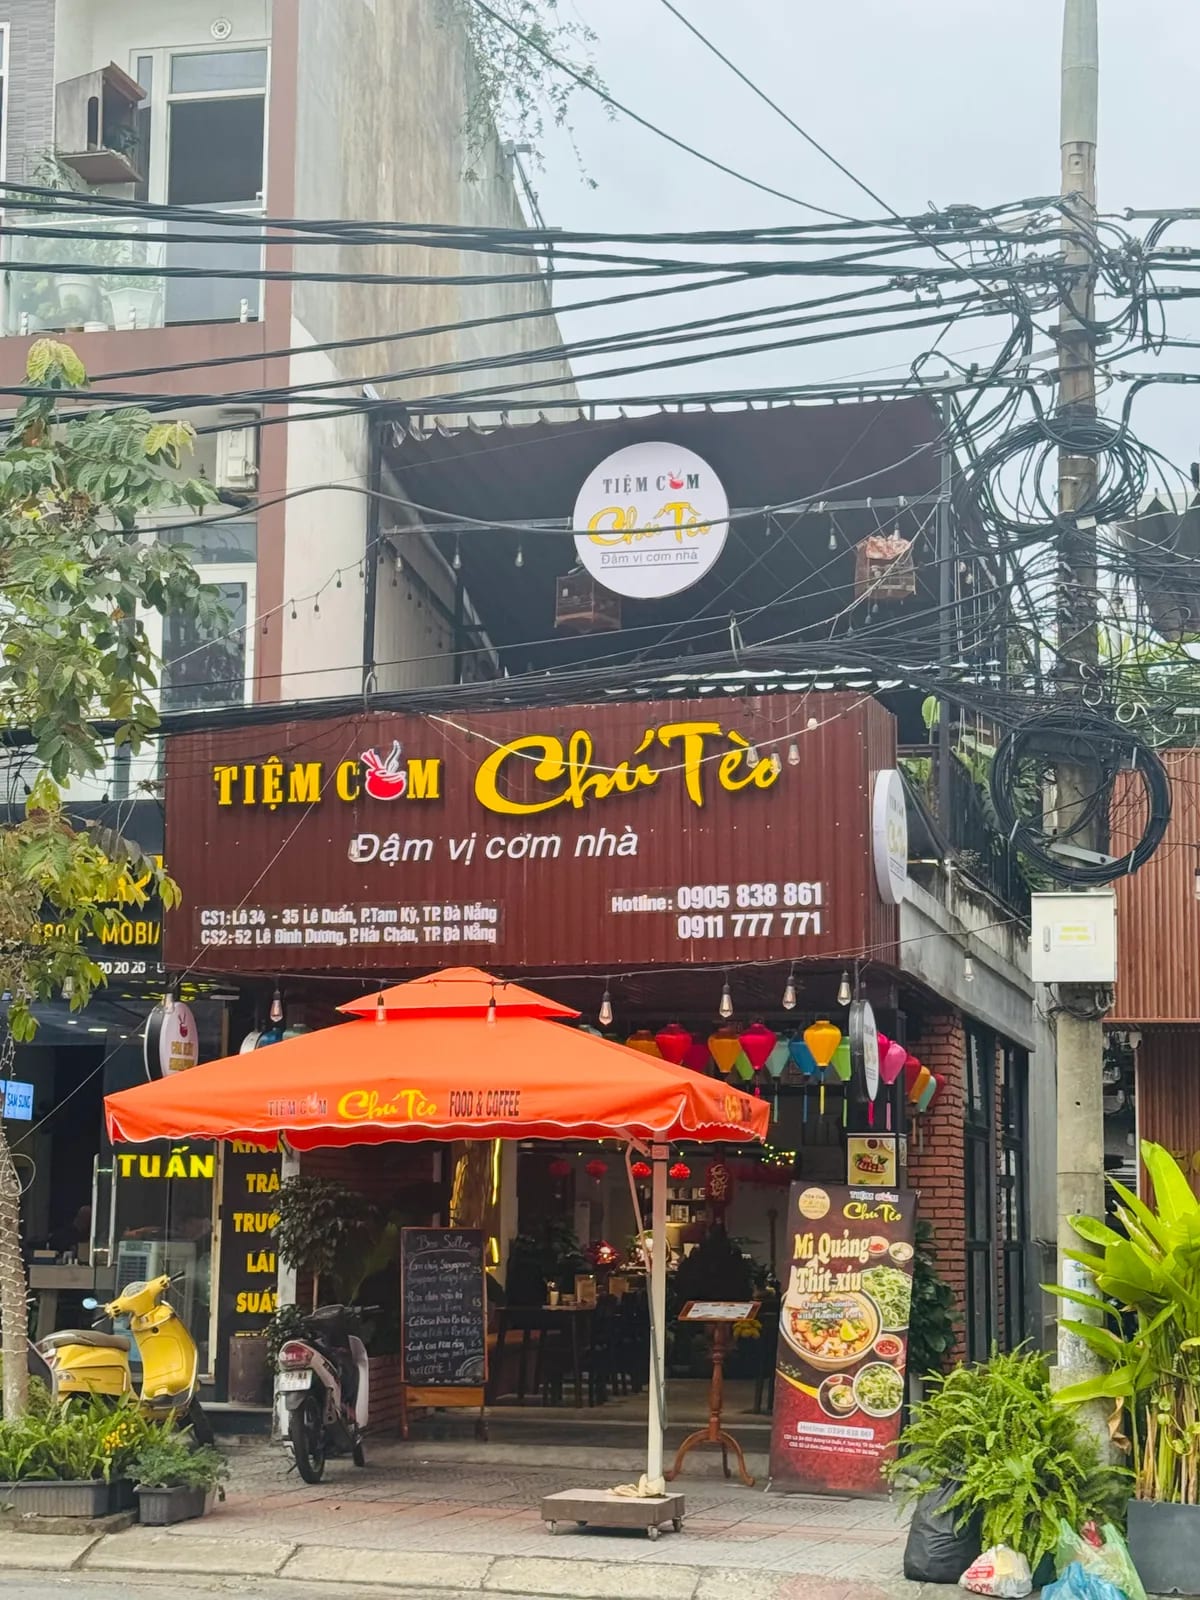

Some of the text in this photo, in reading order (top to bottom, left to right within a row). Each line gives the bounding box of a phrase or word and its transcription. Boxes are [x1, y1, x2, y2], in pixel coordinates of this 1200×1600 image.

[603, 474, 648, 495] TIỆM
[213, 756, 322, 810] TIỆM
[349, 825, 639, 867] Đậm vị cơm nhà
[611, 882, 823, 913] Hotline: 0905 838 861
[249, 909, 266, 925] 34
[282, 908, 300, 925] 35
[303, 907, 319, 925] Lê
[423, 905, 441, 922] TP.
[443, 904, 461, 922] Đà
[677, 912, 821, 939] 0911 777 771
[234, 928, 252, 945] 52
[255, 927, 271, 945] Lê
[383, 924, 419, 944] Châu,
[423, 925, 441, 942] TP.
[443, 924, 461, 942] Đà
[450, 1090, 521, 1118] FOOD & COFFEE
[118, 1146, 215, 1178] TUẤN
[818, 1229, 870, 1264] Quảng
